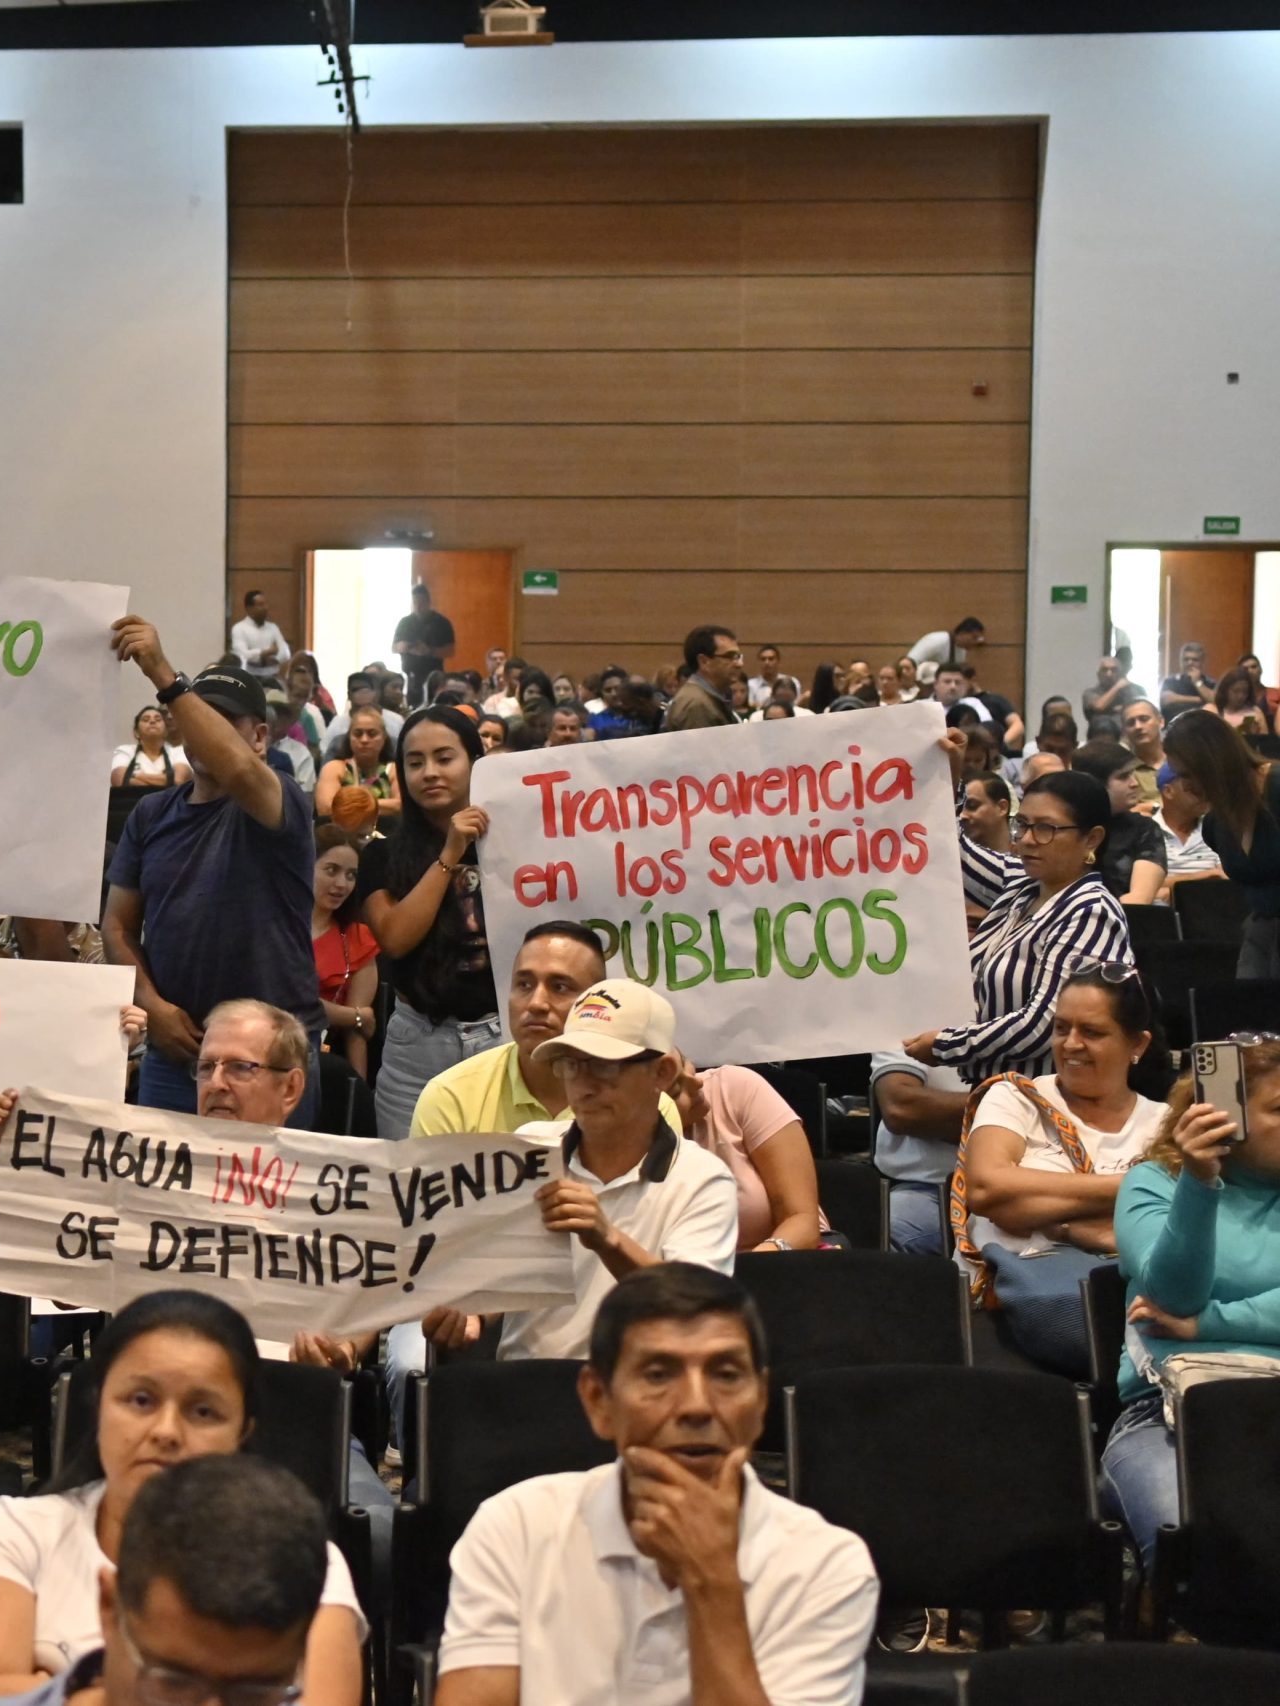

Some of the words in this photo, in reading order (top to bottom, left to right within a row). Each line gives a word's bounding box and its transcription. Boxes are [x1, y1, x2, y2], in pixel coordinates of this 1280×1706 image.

[521, 744, 917, 850] Transparencia
[513, 861, 579, 908] en
[614, 840, 688, 898] los
[707, 816, 929, 887] servicios
[581, 888, 908, 991] PÚBLICOS
[10, 1108, 66, 1178] EL
[82, 1127, 193, 1192] AGUA
[211, 1146, 300, 1215] ¡NO!
[309, 1163, 371, 1215] SE
[388, 1147, 550, 1228] VENDE
[55, 1211, 119, 1261] SE
[139, 1220, 436, 1293] DEFIENDE!
